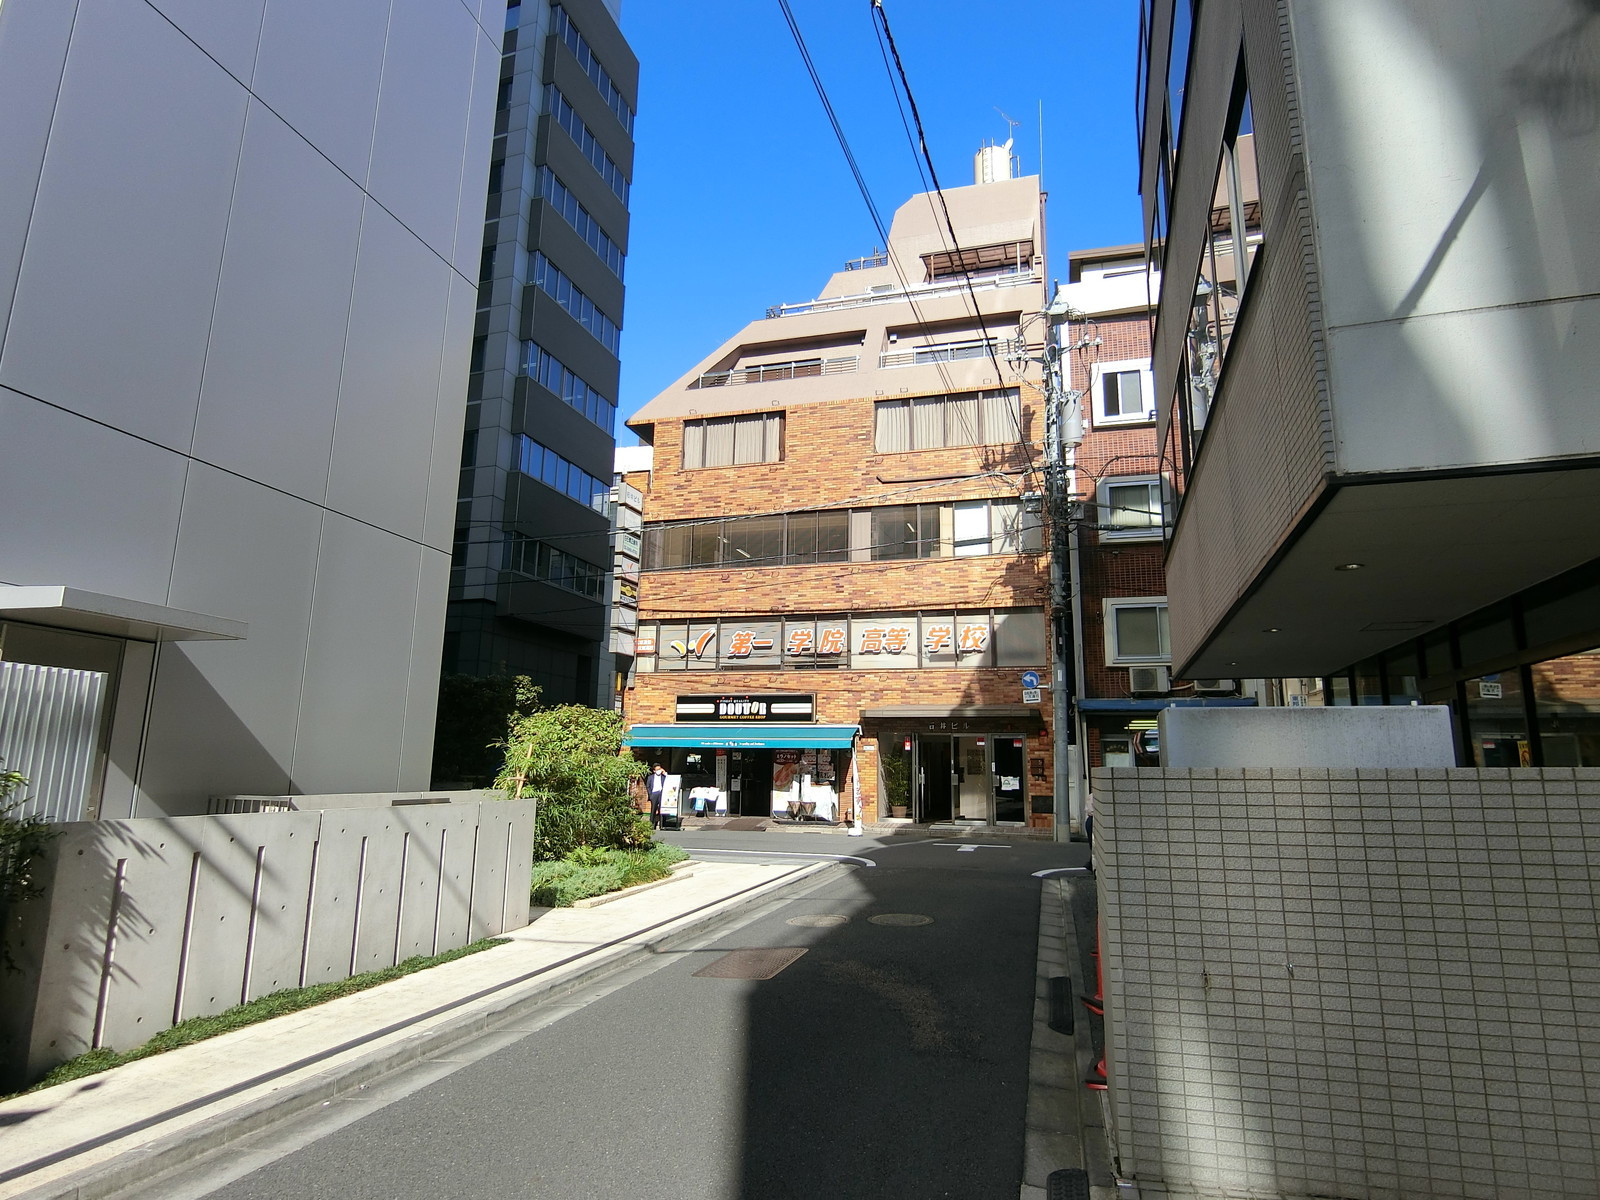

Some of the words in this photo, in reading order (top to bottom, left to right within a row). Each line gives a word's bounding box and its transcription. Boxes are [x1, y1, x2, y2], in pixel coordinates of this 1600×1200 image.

[728, 624, 991, 659] 第一学院高等学校
[719, 701, 766, 715] DOUTOR
